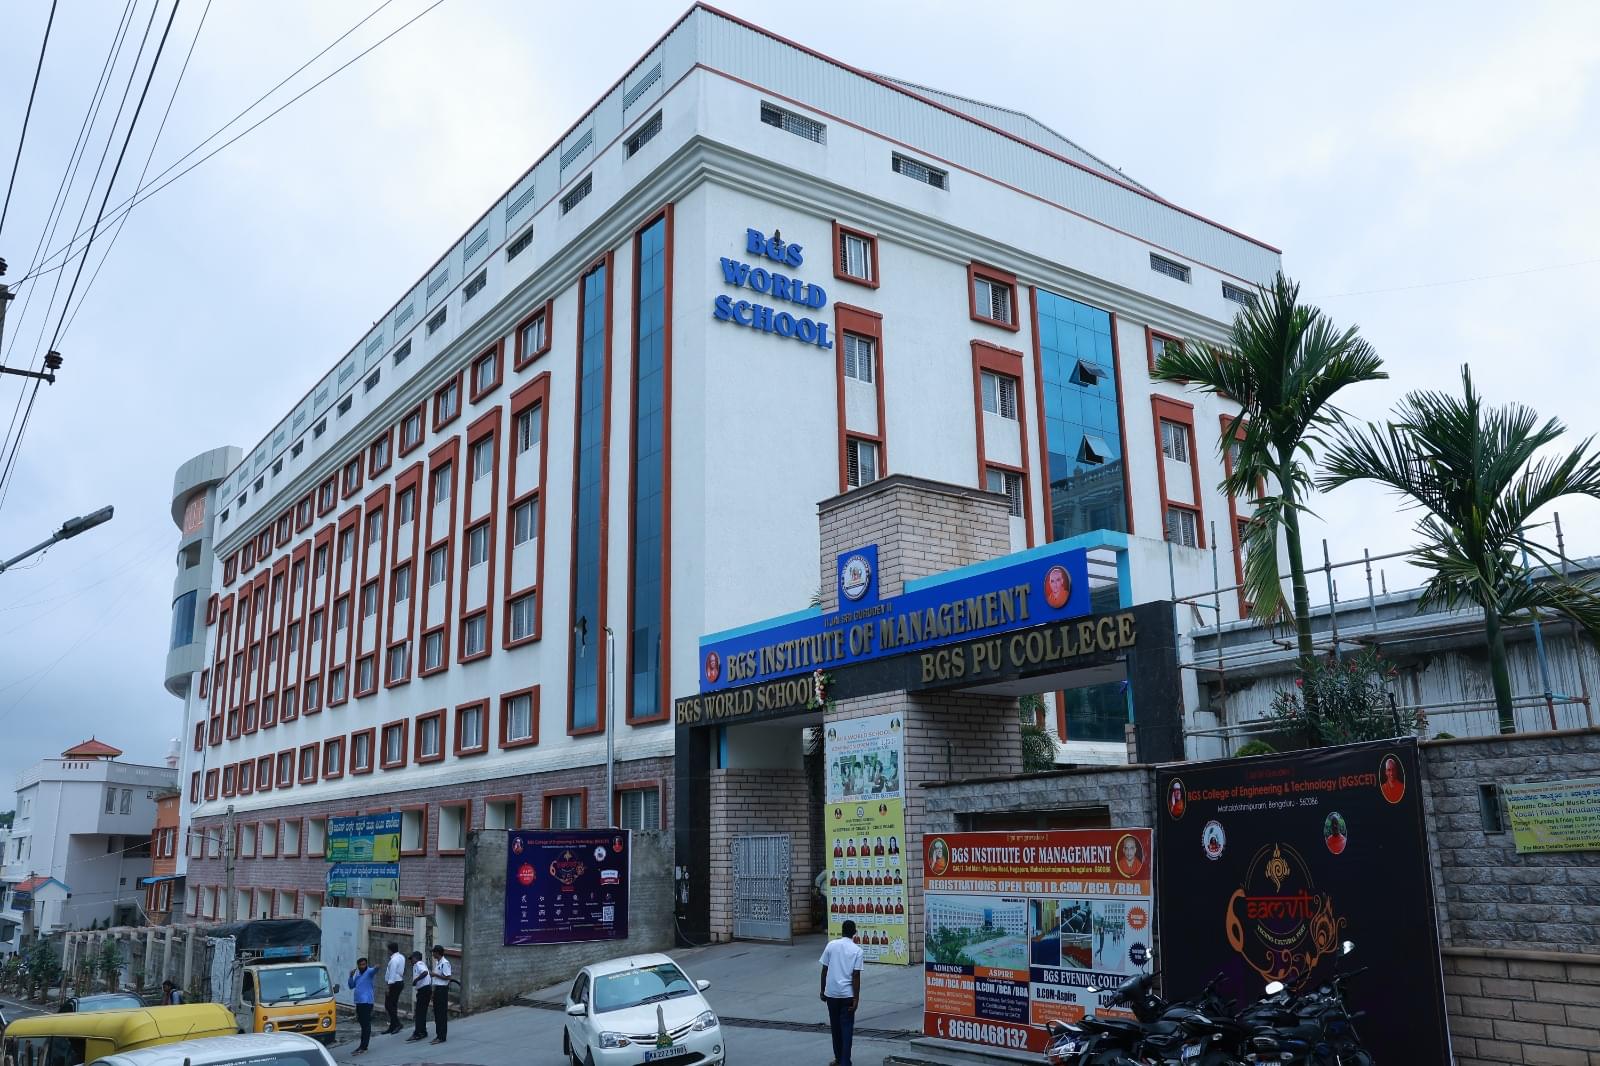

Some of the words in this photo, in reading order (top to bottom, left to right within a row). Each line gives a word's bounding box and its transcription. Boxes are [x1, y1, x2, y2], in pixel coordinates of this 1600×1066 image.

[746, 228, 803, 268] BGS
[720, 257, 827, 308] WORLD
[714, 295, 832, 349] SCHOOL
[726, 649, 757, 682] BGS
[760, 629, 846, 676] INSTITUTE
[850, 620, 874, 656] OF
[880, 583, 1031, 650] MANAGEMENT
[921, 647, 965, 683] BGS
[972, 640, 1003, 674] PU
[1009, 612, 1137, 667] COLLEGE
[676, 698, 700, 724] BGS
[704, 690, 753, 719] WORLD
[757, 677, 816, 711] SCHOOL
[1202, 788, 1229, 802] College
[1231, 786, 1239, 797] of
[1239, 784, 1282, 798] Engineering
[1291, 778, 1337, 792] Technology
[1338, 773, 1376, 791] (BGSCET)
[952, 847, 968, 863] BGS
[972, 846, 1020, 864] INSTITUTE
[1023, 847, 1035, 863] OF
[1038, 846, 1111, 864] MANAGEMENT
[929, 879, 997, 892] REGISTRATIONS
[998, 881, 1022, 892] OPEN
[1024, 881, 1042, 893] FOR
[975, 981, 995, 993] B.COM
[988, 969, 1014, 979] ASPIRE
[1043, 969, 1059, 983] BGS
[1061, 971, 1096, 987] EVENING
[1098, 974, 1127, 989] COLLE
[1036, 988, 1077, 1002] B.COM-Aspire
[949, 1019, 1028, 1048] 8660468132
